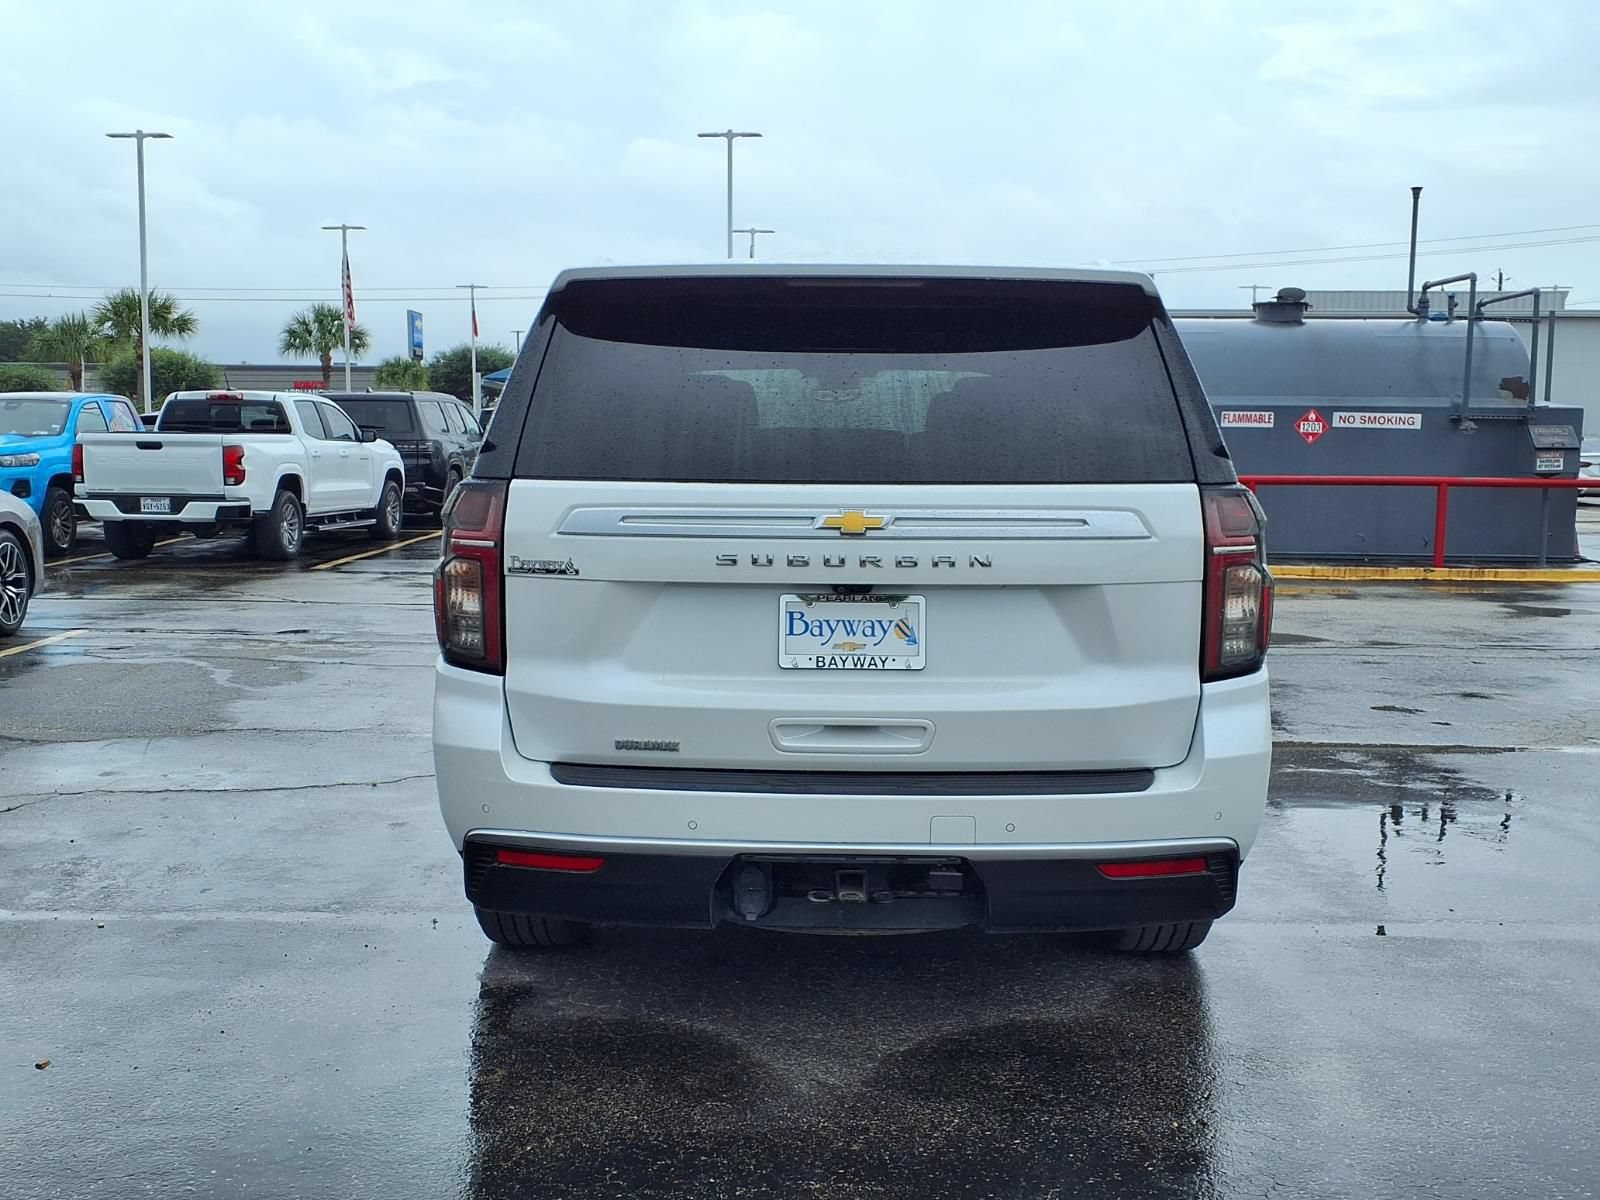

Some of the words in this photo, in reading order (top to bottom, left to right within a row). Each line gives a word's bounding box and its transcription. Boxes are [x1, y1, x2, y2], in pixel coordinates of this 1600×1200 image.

[1222, 413, 1273, 425] FLAMMABLE
[1338, 415, 1356, 424] NO
[1359, 415, 1416, 426] SMOKING
[1303, 422, 1321, 432] 1203
[509, 555, 566, 574] Bayway
[715, 553, 993, 568] SUBURBAN
[786, 610, 895, 646] Bayway
[815, 655, 890, 668] BAYWAY
[614, 739, 681, 753] DURAMAX
